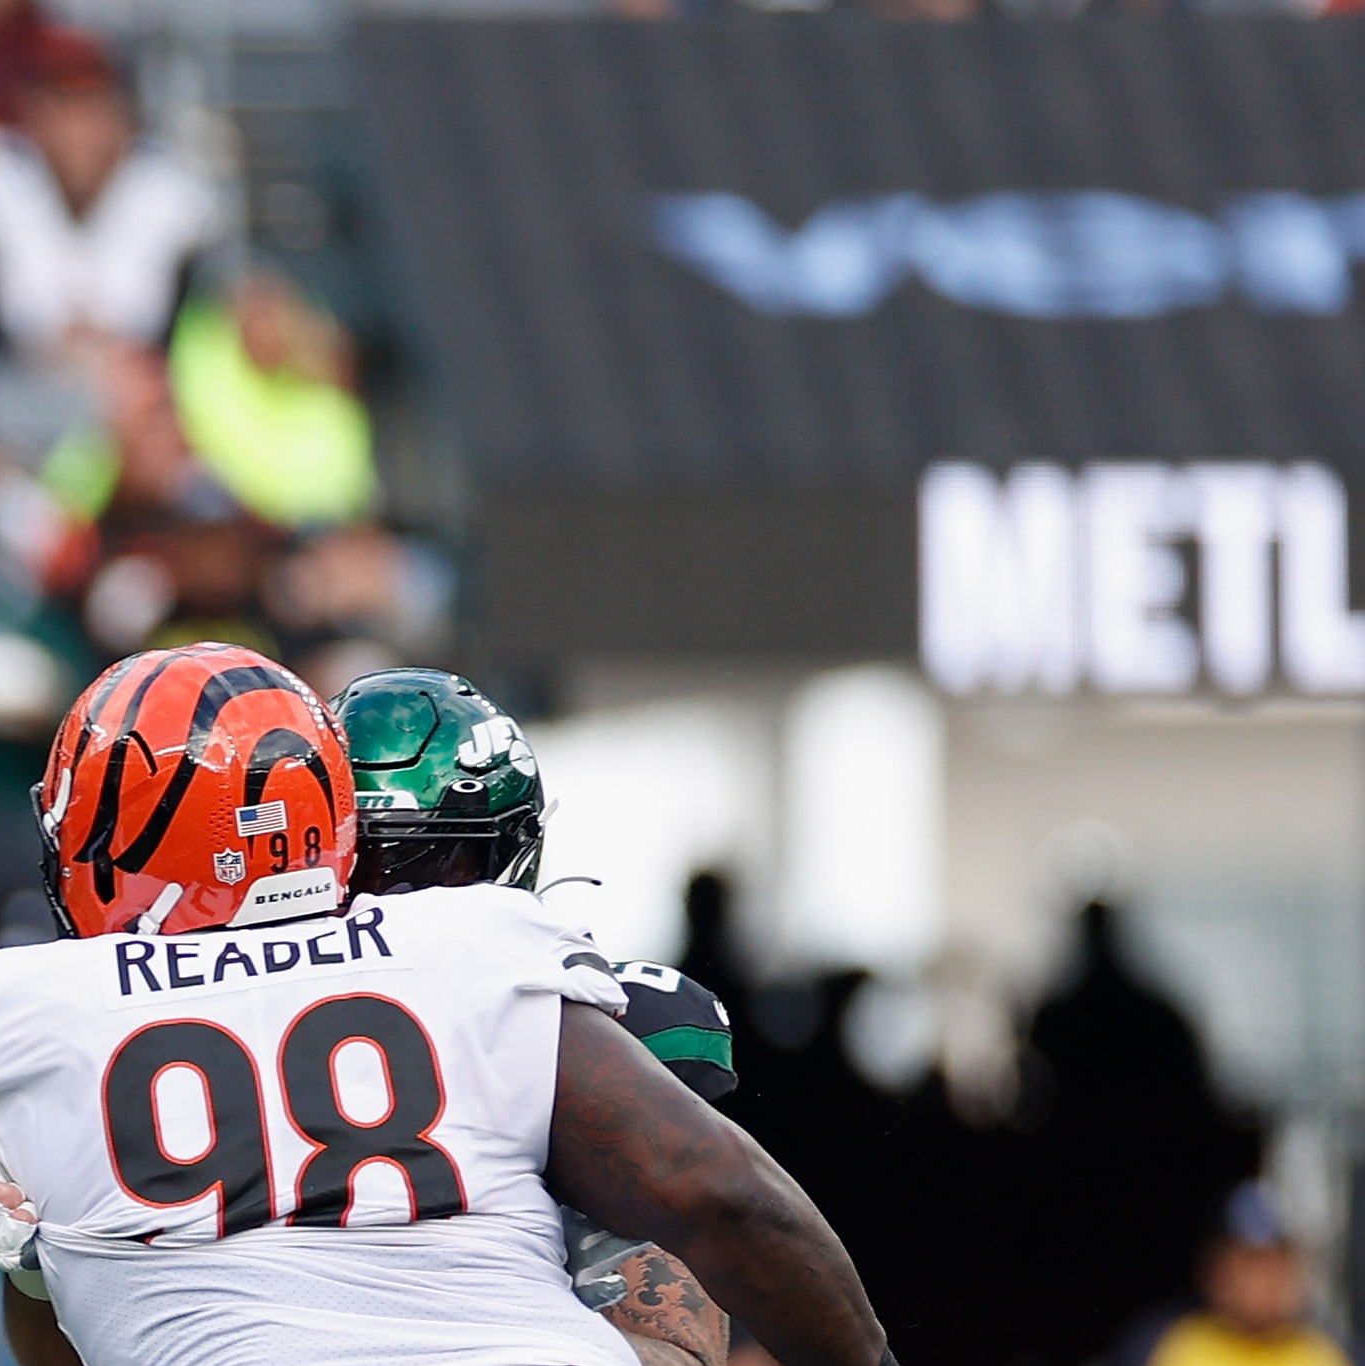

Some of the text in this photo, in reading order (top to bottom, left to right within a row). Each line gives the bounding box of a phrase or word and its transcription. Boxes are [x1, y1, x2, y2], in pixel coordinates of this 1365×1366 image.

[255, 882, 332, 905] BENGALS
[115, 906, 393, 996] READER
[101, 991, 469, 1242] 98
